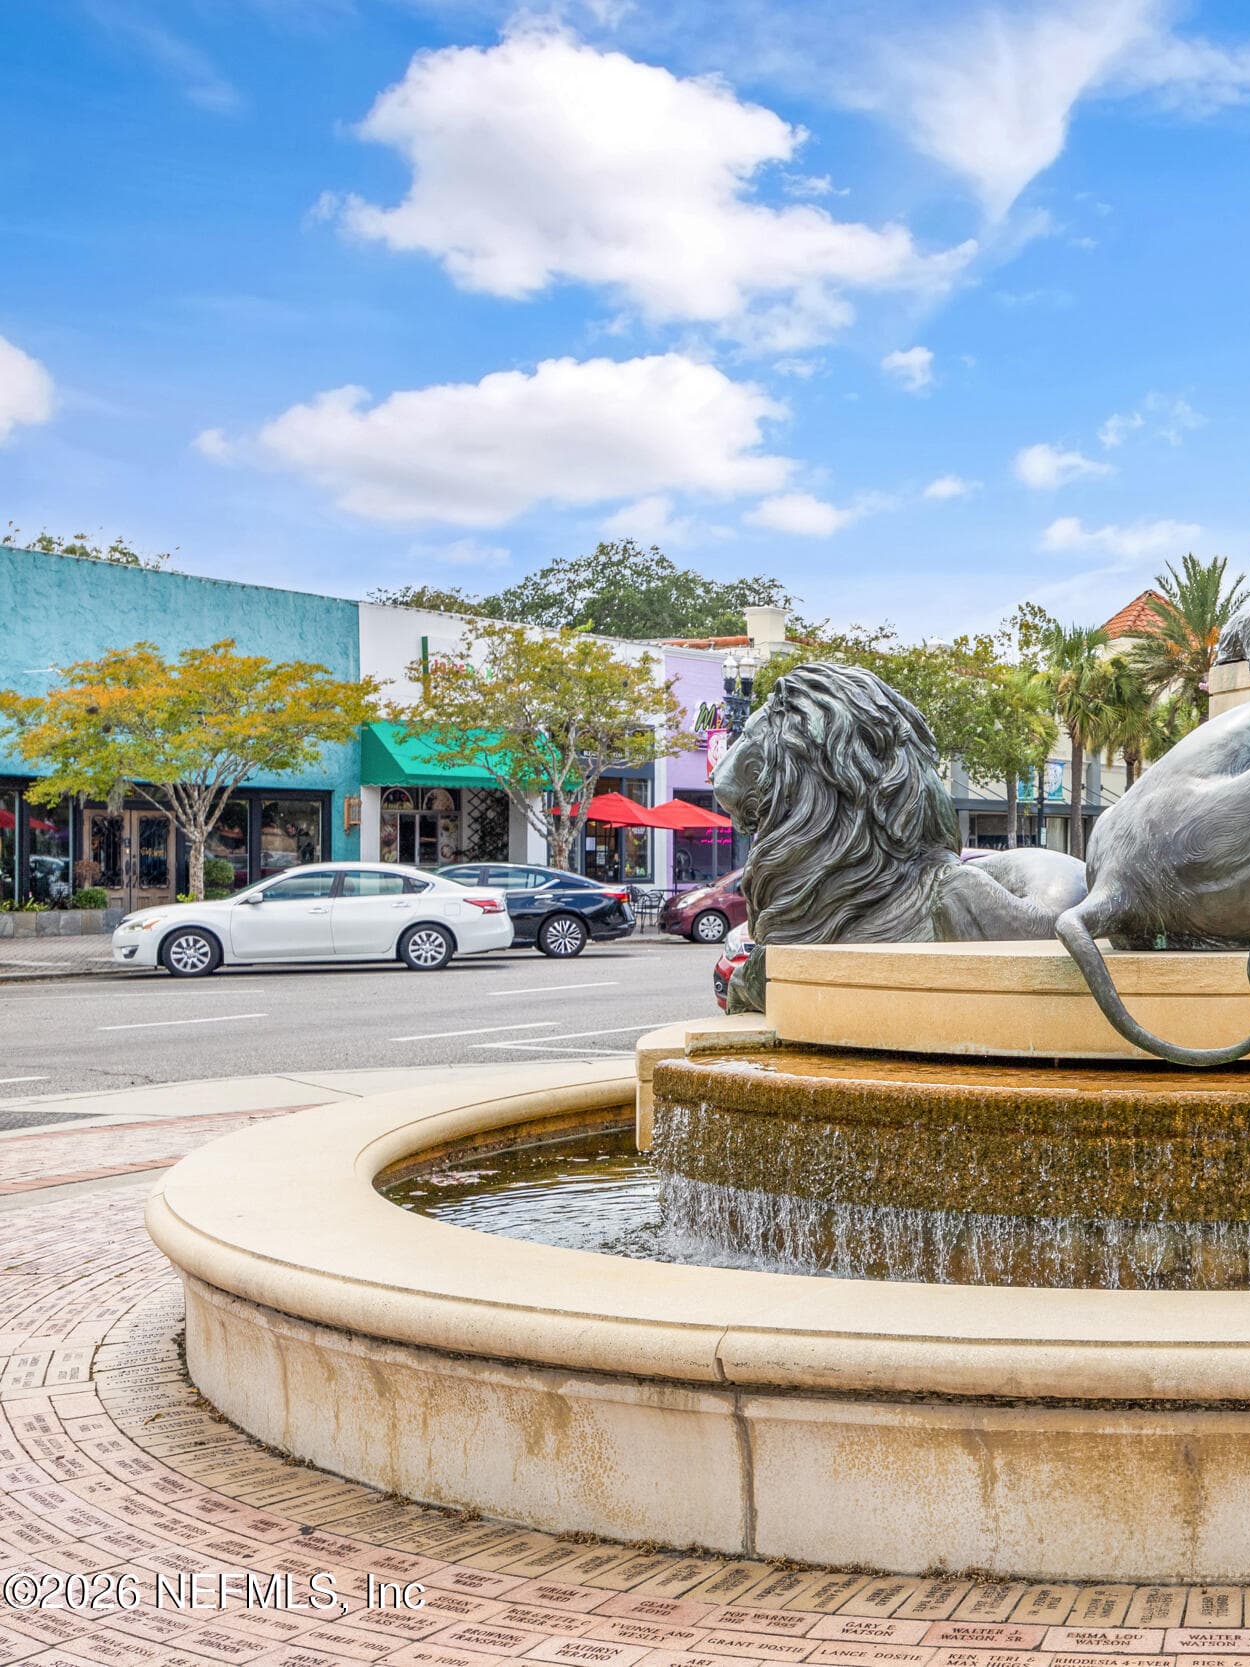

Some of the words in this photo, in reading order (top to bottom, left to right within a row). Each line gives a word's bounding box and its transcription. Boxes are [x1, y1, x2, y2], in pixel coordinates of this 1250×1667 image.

[280, 1558, 310, 1570] ANGEL
[453, 1572, 491, 1584] ALBERT
[453, 1578, 483, 1588] WARD
[538, 1585, 579, 1597] MIRIAM
[434, 1596, 472, 1608] SUSAN
[538, 1593, 571, 1603] WARD
[426, 1601, 472, 1615] MADDOX
[632, 1606, 672, 1616] FLOYD
[235, 1613, 266, 1625] ALLEN
[269, 1620, 300, 1631] TODD
[359, 1615, 396, 1627] CLASS
[367, 1610, 415, 1623] LANDON
[503, 1614, 547, 1627] PURSER
[508, 1608, 531, 1617] BOB
[541, 1613, 575, 1624] BETTE
[753, 1613, 805, 1623] WARNER
[611, 1622, 661, 1635] YVONNE
[664, 1631, 695, 1639] AND
[845, 1622, 882, 1630] GARY
[463, 1628, 525, 1642] BROWNING
[618, 1631, 667, 1643] WESLEY
[841, 1628, 895, 1637] WATSON
[193, 1638, 241, 1653] JOHNSON
[230, 1639, 268, 1651] JONES
[308, 1631, 355, 1645] CHARLIE
[357, 1641, 392, 1652] TODD
[450, 1633, 518, 1648] TRANSPORT
[707, 1637, 754, 1649] GRANT
[758, 1643, 807, 1654] DOSTIE
[563, 1643, 623, 1655] KATHRYN
[820, 1649, 868, 1658] LANCE
[874, 1652, 924, 1661] DOSTIE
[435, 1656, 470, 1667] TODD
[555, 1650, 612, 1662] PERAINO
[1055, 1658, 1119, 1666] RHODESIA
